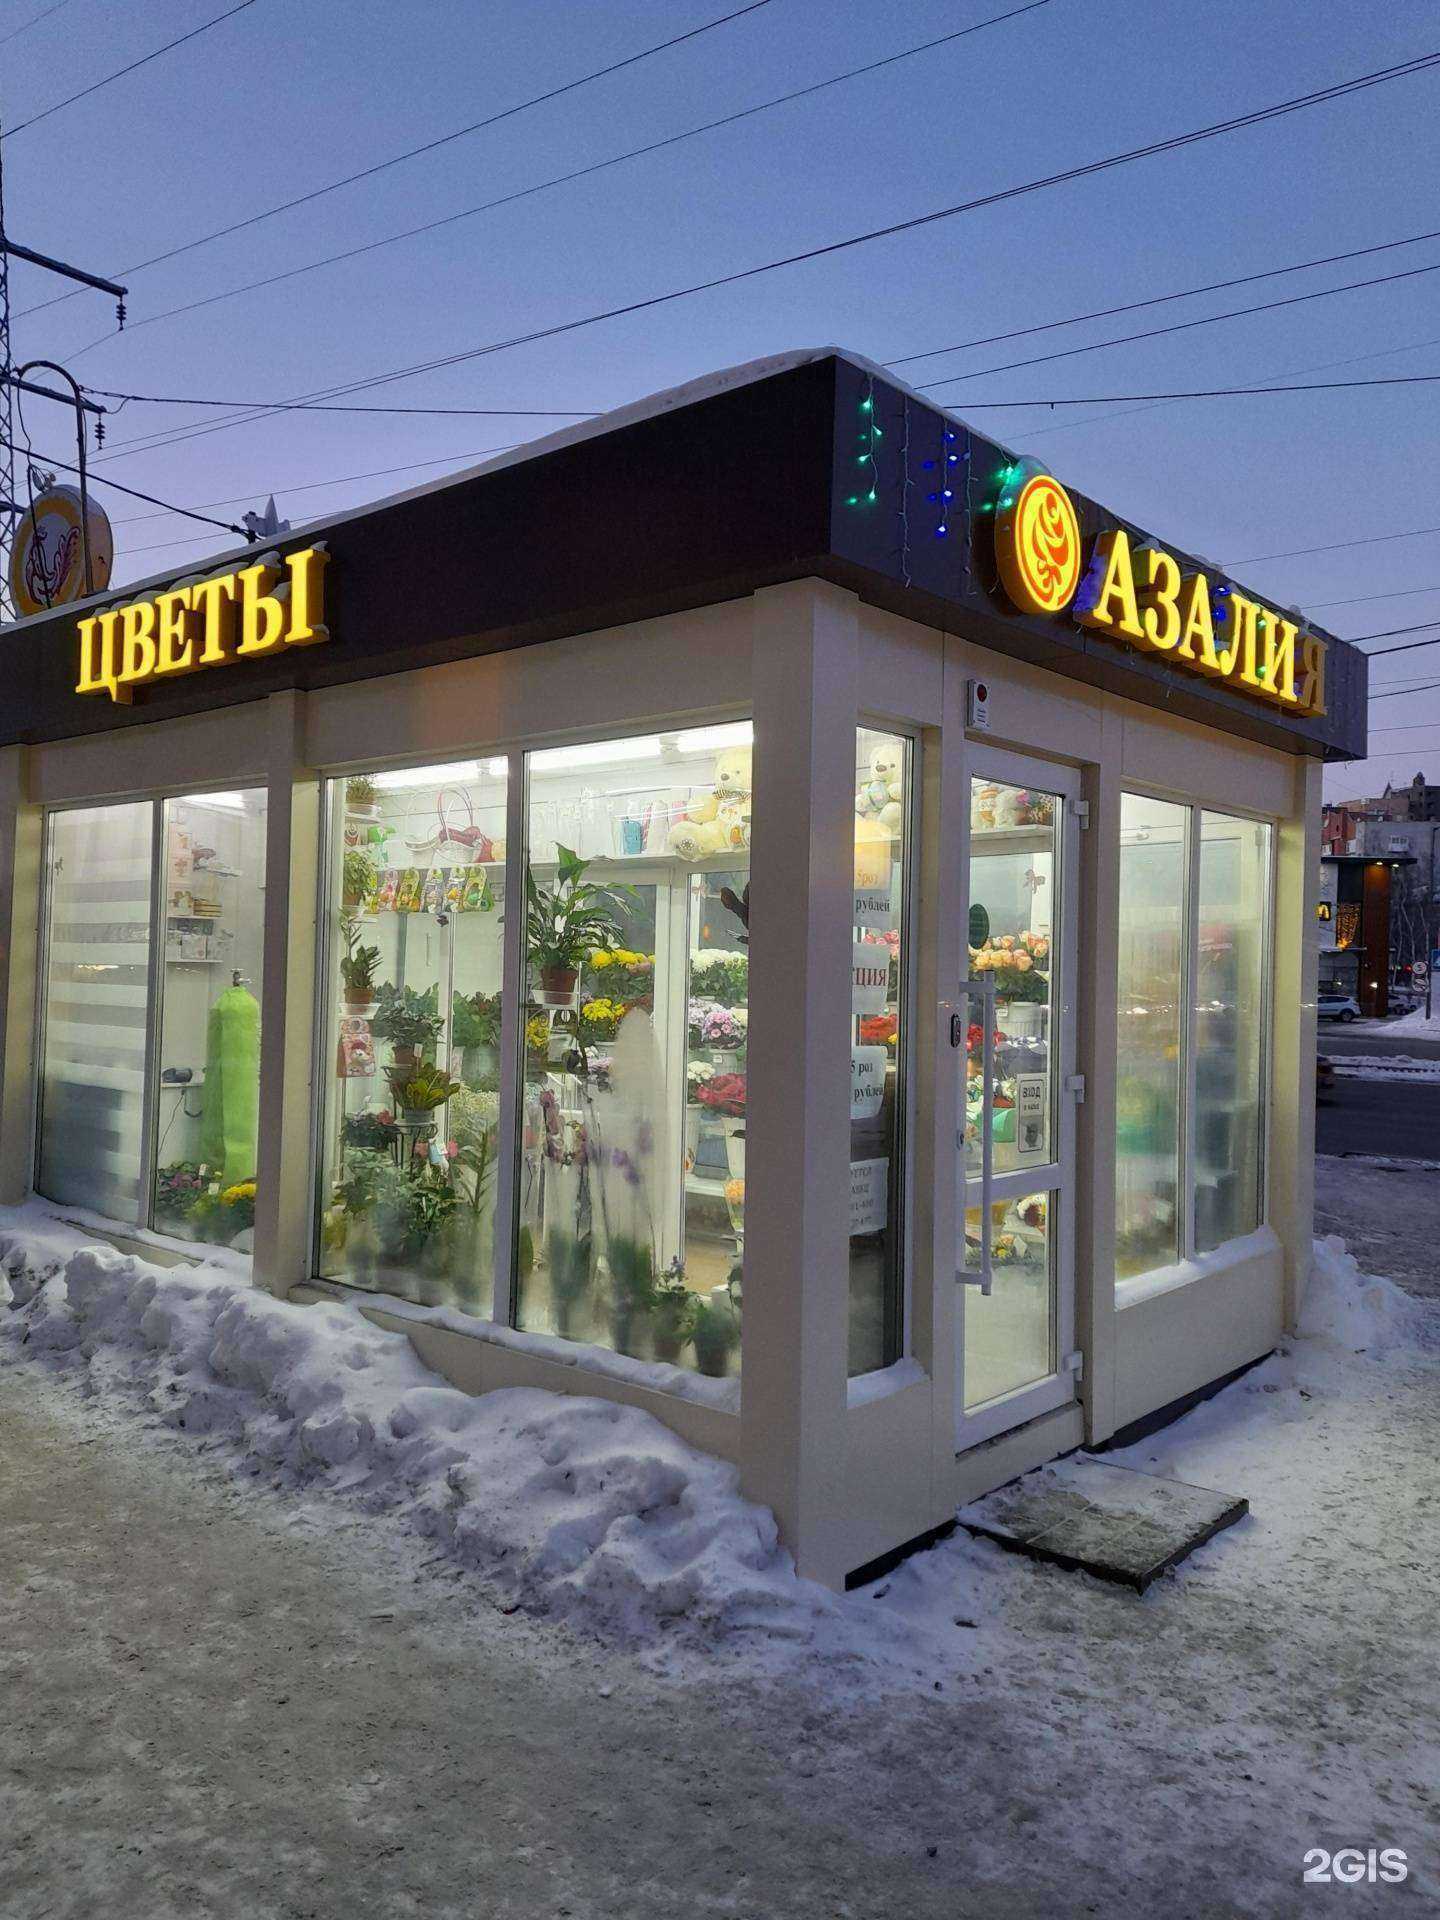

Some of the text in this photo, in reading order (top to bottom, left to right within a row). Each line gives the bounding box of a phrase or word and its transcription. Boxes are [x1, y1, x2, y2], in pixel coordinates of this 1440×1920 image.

[75, 548, 317, 702] ЦВЕТЫ
[1092, 529, 1328, 716] АЗАЛИЯ
[852, 966, 887, 988] ЦИЯ
